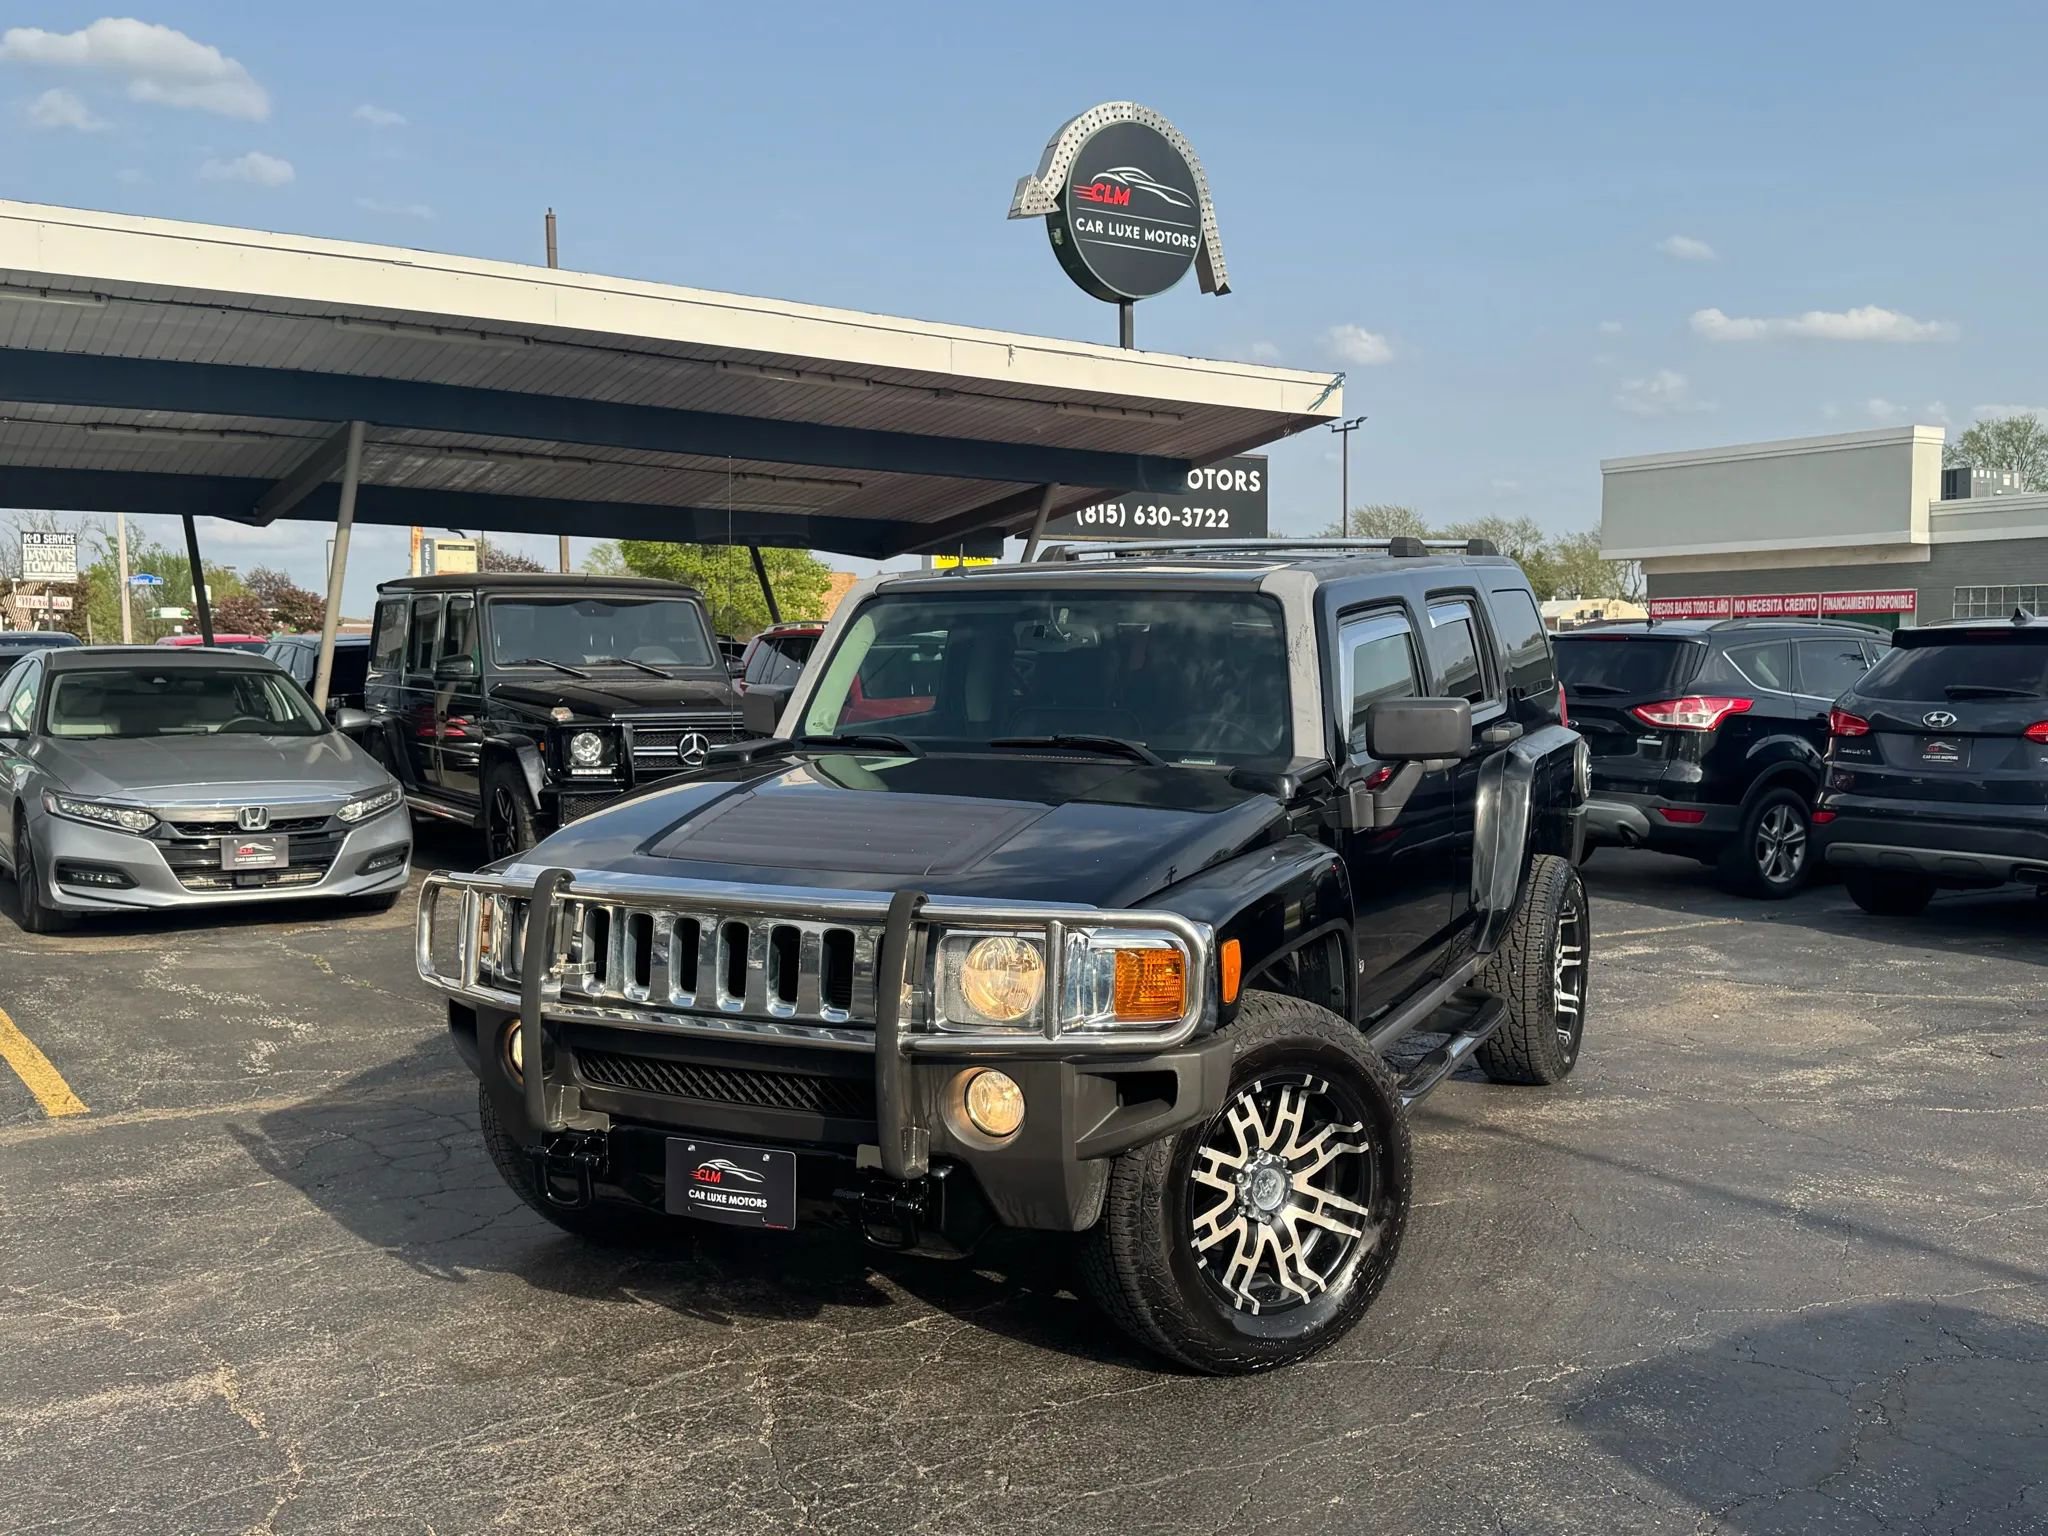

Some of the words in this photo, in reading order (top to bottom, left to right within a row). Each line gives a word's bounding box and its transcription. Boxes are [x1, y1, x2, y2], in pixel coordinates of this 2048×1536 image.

[1090, 183, 1132, 206] CLM
[1076, 217, 1104, 234] CAR
[1108, 222, 1140, 240] LUXE
[1144, 229, 1197, 249] MOTORS
[1187, 468, 1261, 492] OTORS
[1076, 503, 1126, 528] (815)
[1134, 505, 1229, 528] 630-3722
[43, 533, 75, 544] SERVICE
[24, 561, 76, 572] TOWING
[1651, 602, 1674, 615] PRECIOS
[1675, 601, 1692, 614] BAJOS
[1693, 601, 1708, 613] TODO
[1709, 600, 1716, 613] EL
[1717, 599, 1729, 613] AÑO
[1734, 600, 1745, 612] NO
[1747, 598, 1782, 613] NECESITA
[1784, 597, 1817, 612] CREDITO
[1823, 595, 1874, 611] FINANCIAMIENTO
[1876, 594, 1913, 609] DISPONIBLE
[697, 1169, 721, 1183] CLM
[688, 1189, 705, 1200] CAR
[707, 1192, 727, 1204] LUXE
[728, 1196, 768, 1208] MOTORS
